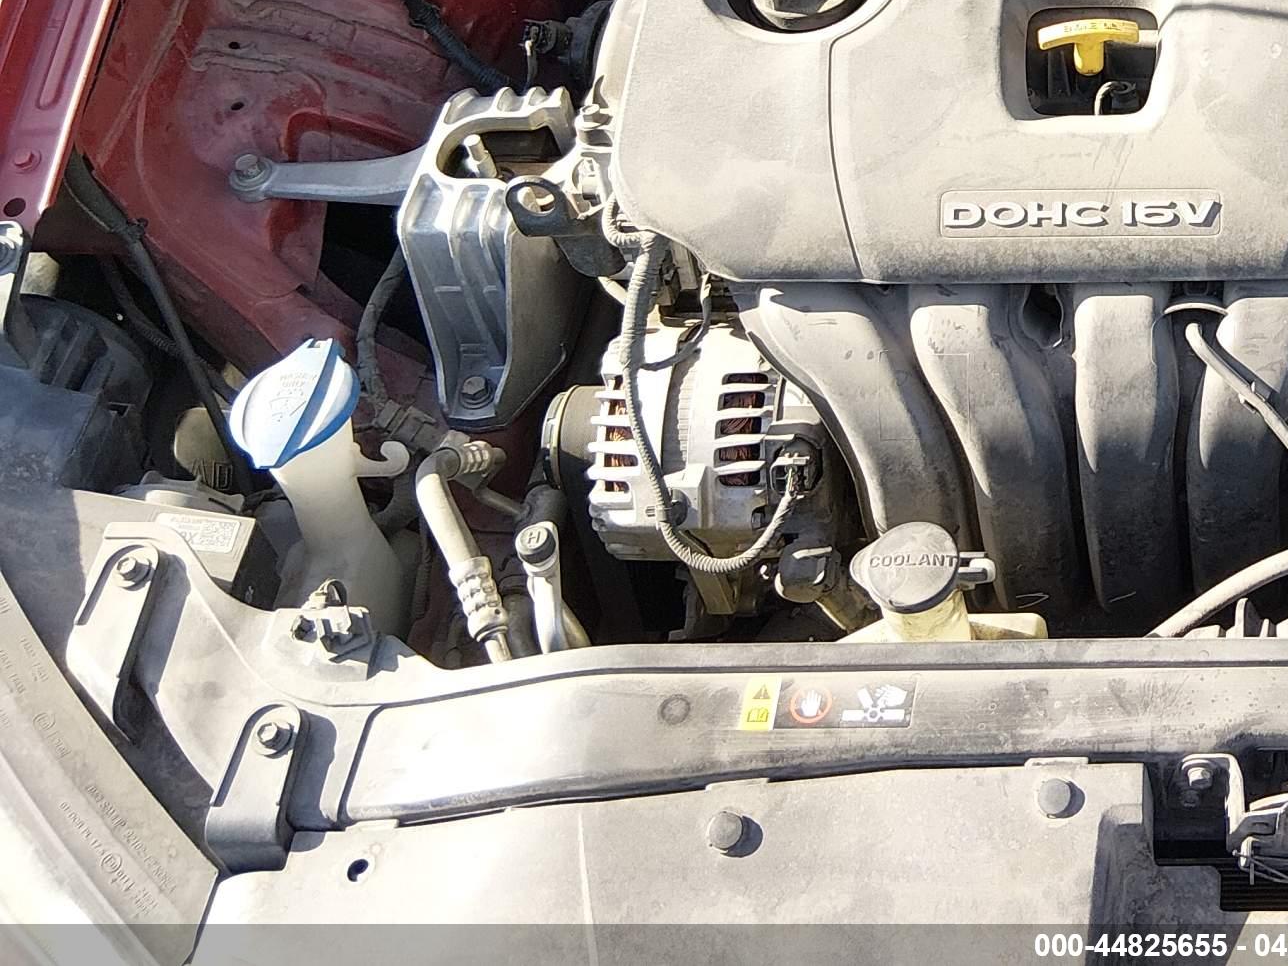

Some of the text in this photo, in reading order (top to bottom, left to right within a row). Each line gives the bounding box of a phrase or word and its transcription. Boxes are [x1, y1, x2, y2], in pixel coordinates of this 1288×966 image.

[943, 200, 1222, 228] DOHC 16V
[527, 531, 541, 545] H
[869, 553, 957, 568] COOLANT
